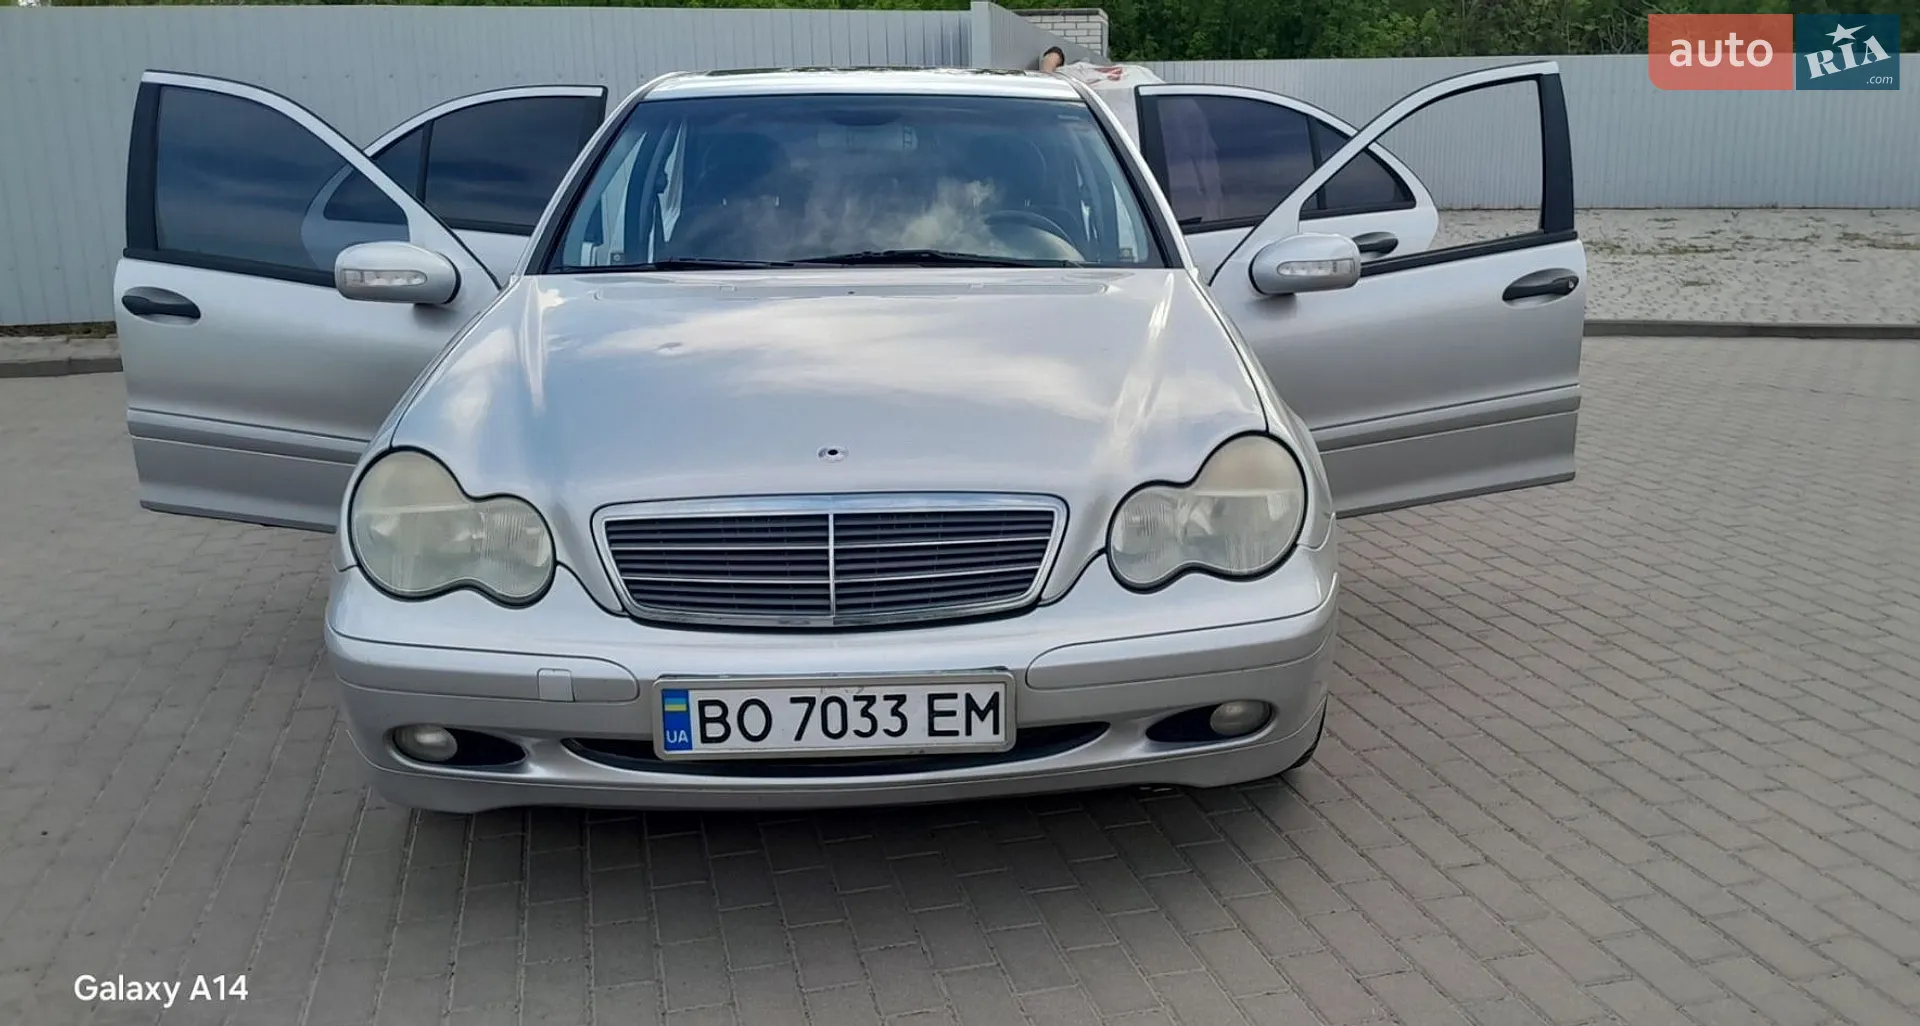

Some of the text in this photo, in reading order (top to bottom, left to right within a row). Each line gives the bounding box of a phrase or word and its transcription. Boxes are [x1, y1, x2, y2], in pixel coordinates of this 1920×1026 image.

[697, 691, 1000, 744] BO 7033 EM
[666, 729, 689, 744] UA
